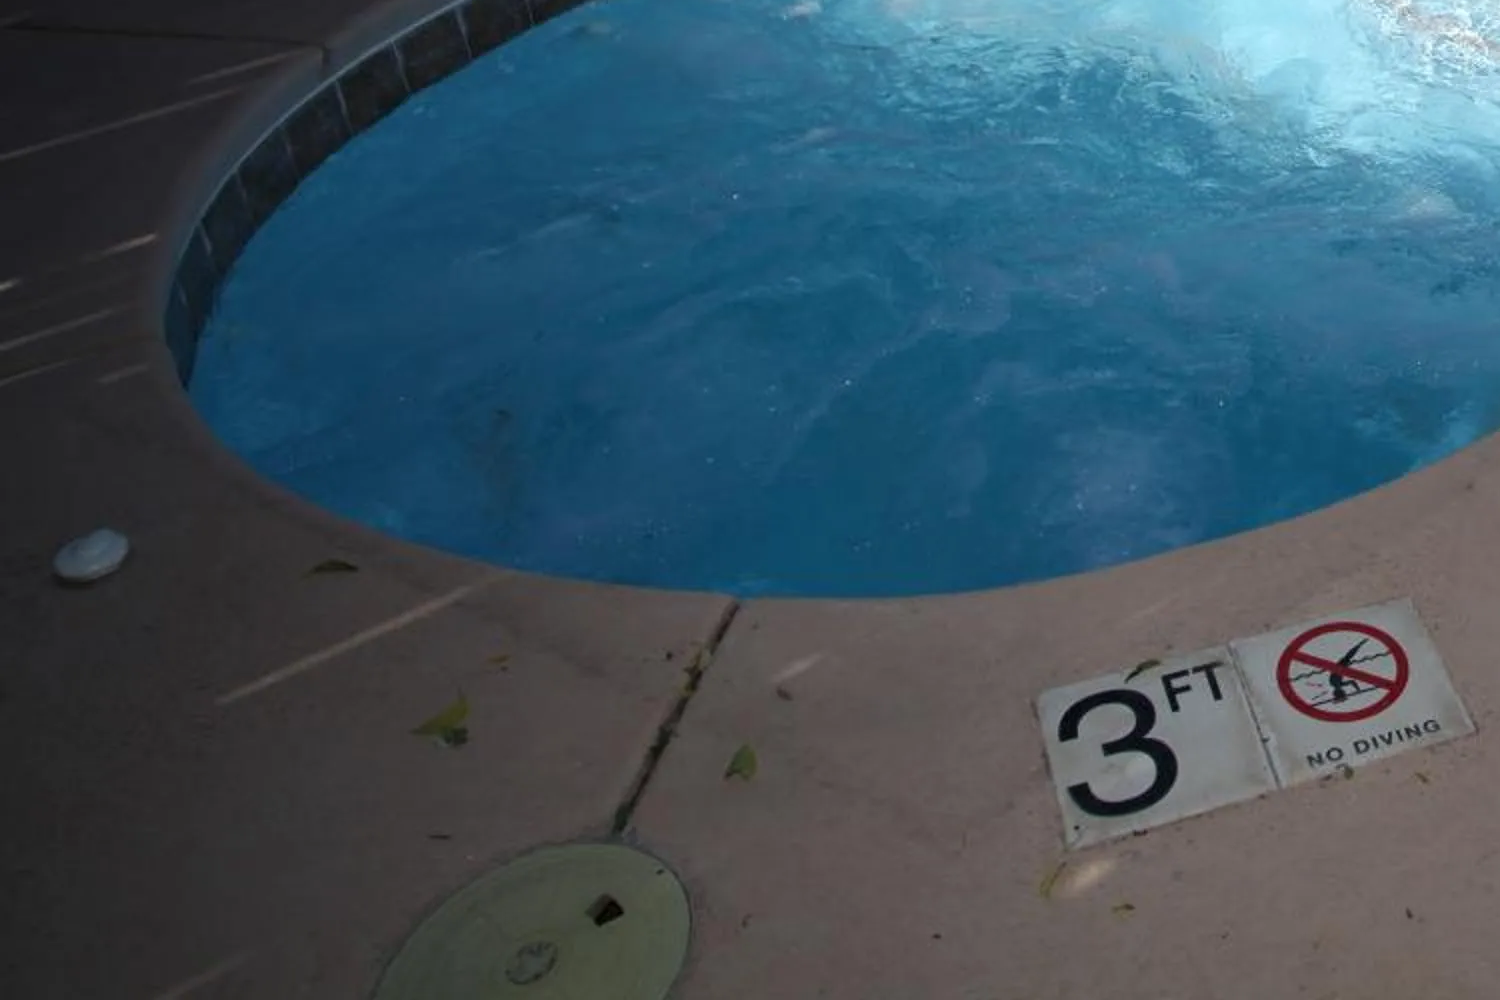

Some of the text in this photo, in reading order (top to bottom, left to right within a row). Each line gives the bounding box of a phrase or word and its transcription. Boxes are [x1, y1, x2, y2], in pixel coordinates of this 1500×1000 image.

[1058, 661, 1225, 817] 3 FT
[1306, 719, 1442, 768] NO DIVING
